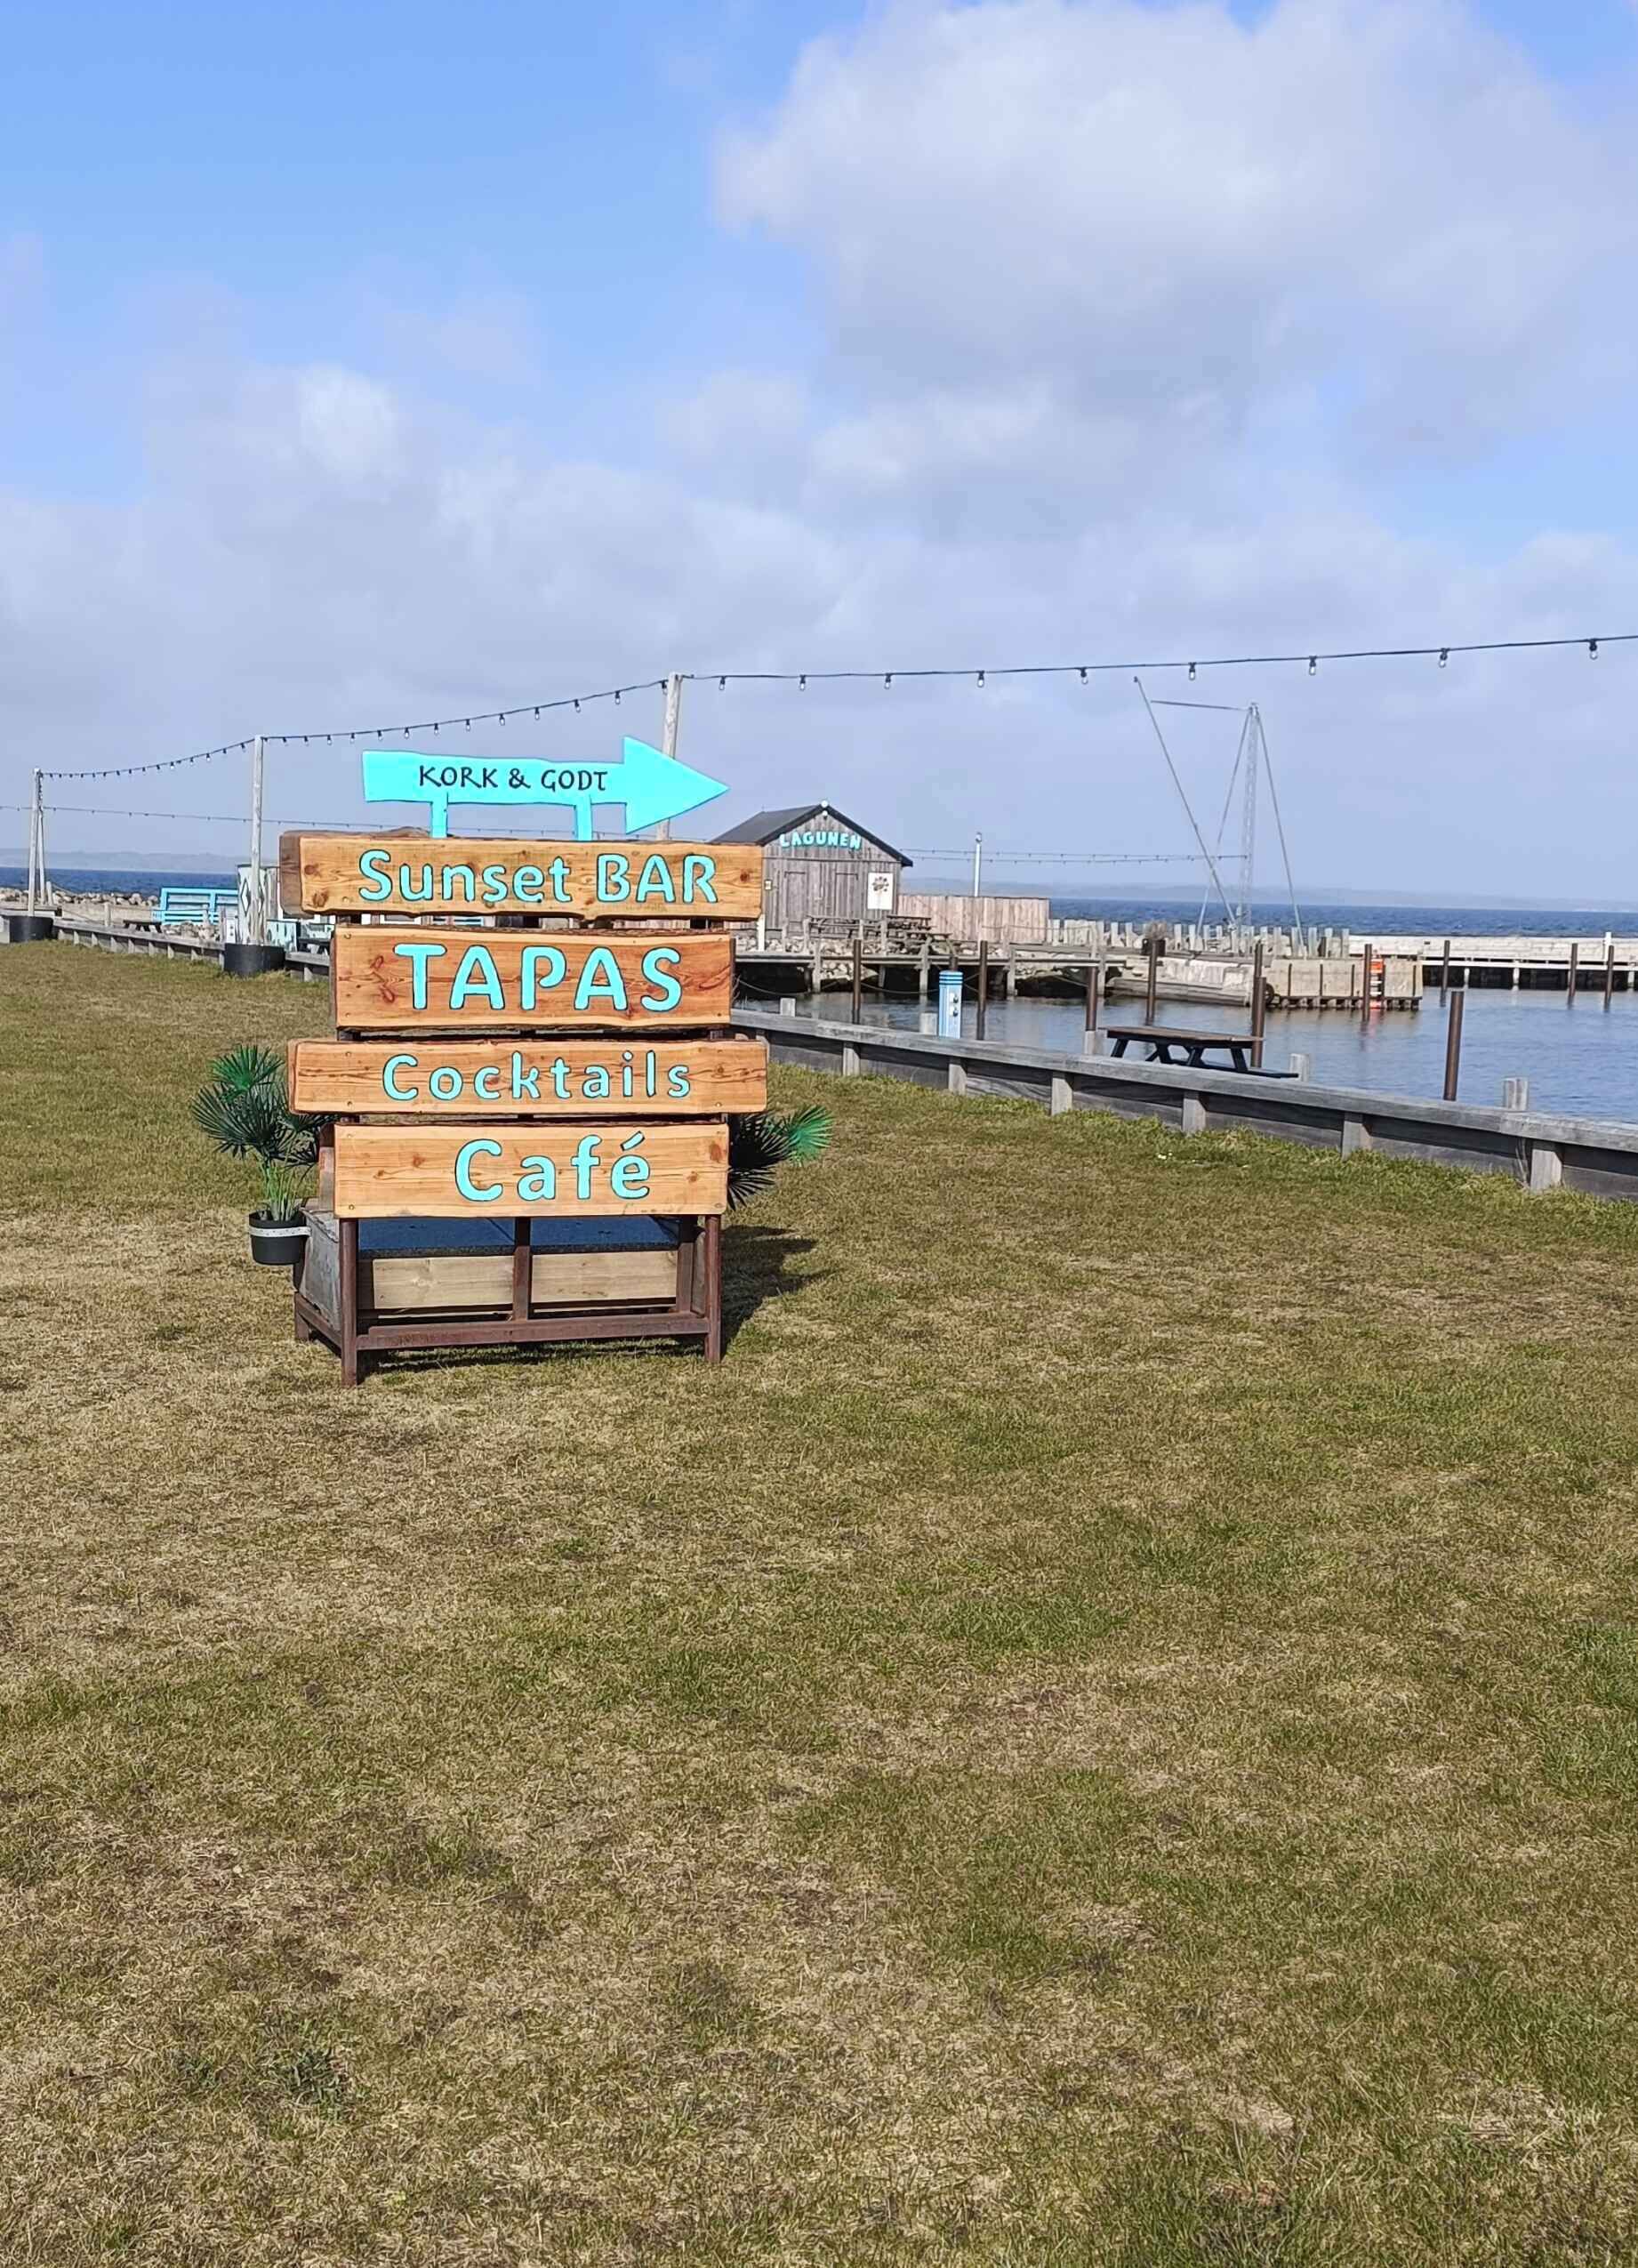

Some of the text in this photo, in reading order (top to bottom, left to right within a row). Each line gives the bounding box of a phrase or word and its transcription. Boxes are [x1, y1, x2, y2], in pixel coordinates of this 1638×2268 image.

[419, 766, 608, 792] KORK & GODT
[779, 831, 863, 850] LAGUNEN
[357, 849, 719, 905] Sunset BAR
[394, 943, 683, 1011] TAPAS
[382, 1050, 691, 1101] Cocktails
[454, 1130, 650, 1202] Café
